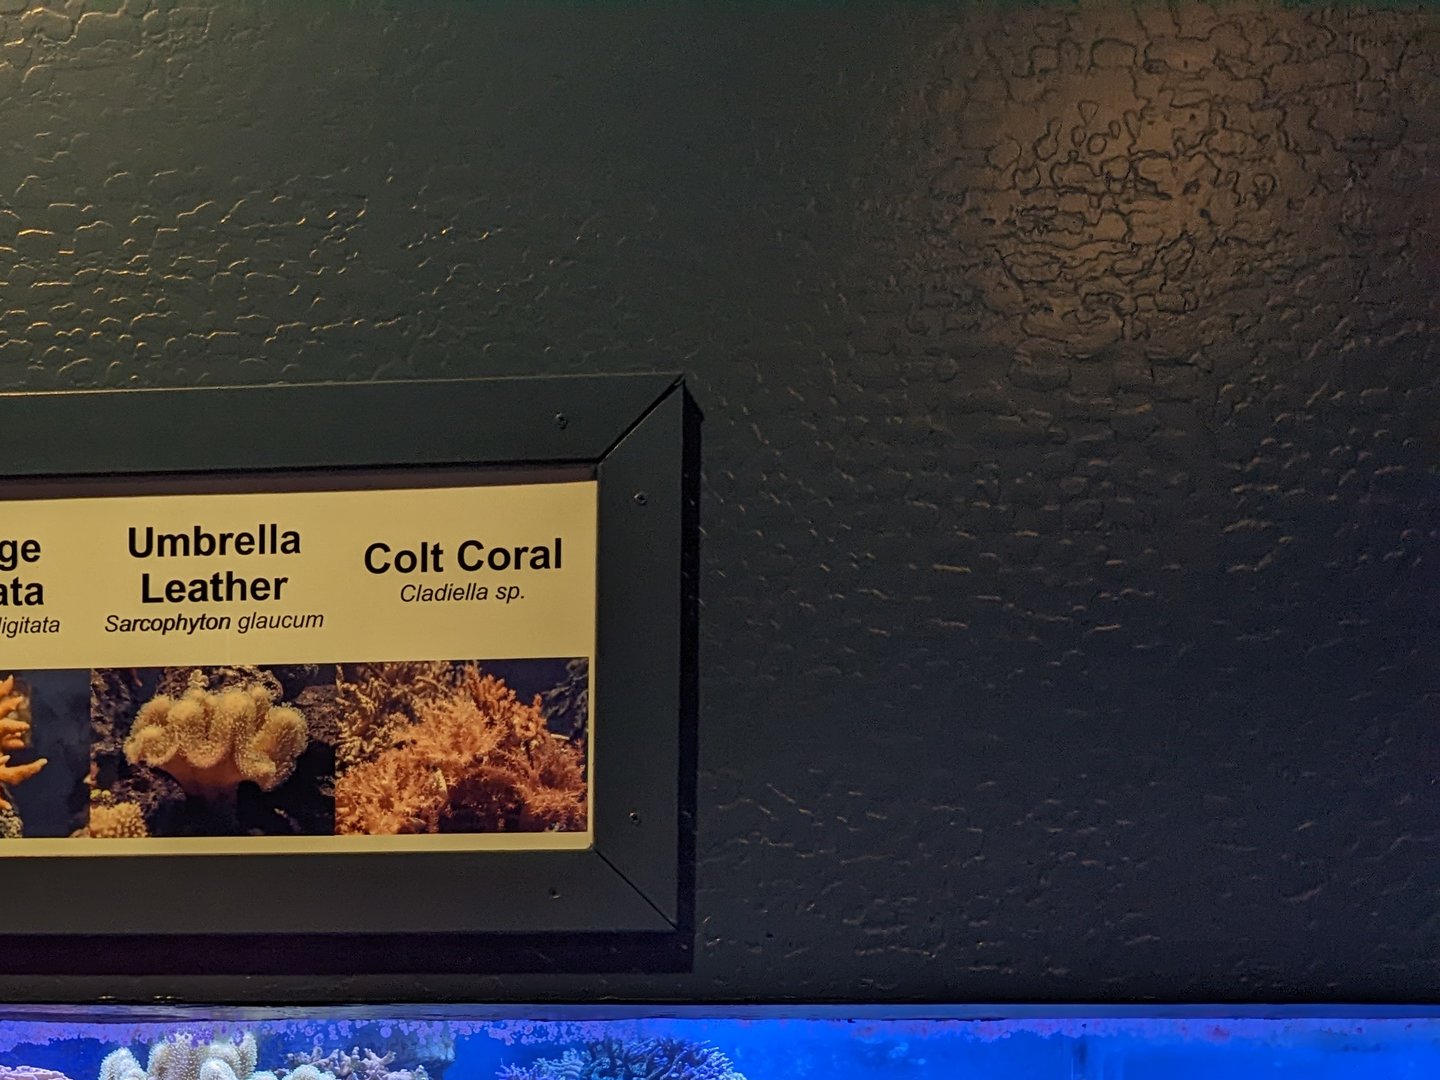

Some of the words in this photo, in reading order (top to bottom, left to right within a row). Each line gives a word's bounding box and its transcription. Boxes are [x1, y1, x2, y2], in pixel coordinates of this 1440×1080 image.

[128, 523, 301, 558] Umbrella
[364, 541, 444, 574] Colt
[457, 537, 561, 572] Coral
[142, 570, 288, 603] Leather
[400, 582, 488, 602] Cladiella
[495, 585, 524, 604] sp.
[104, 613, 231, 635] Sarcophyton
[237, 611, 324, 634] glaucum
